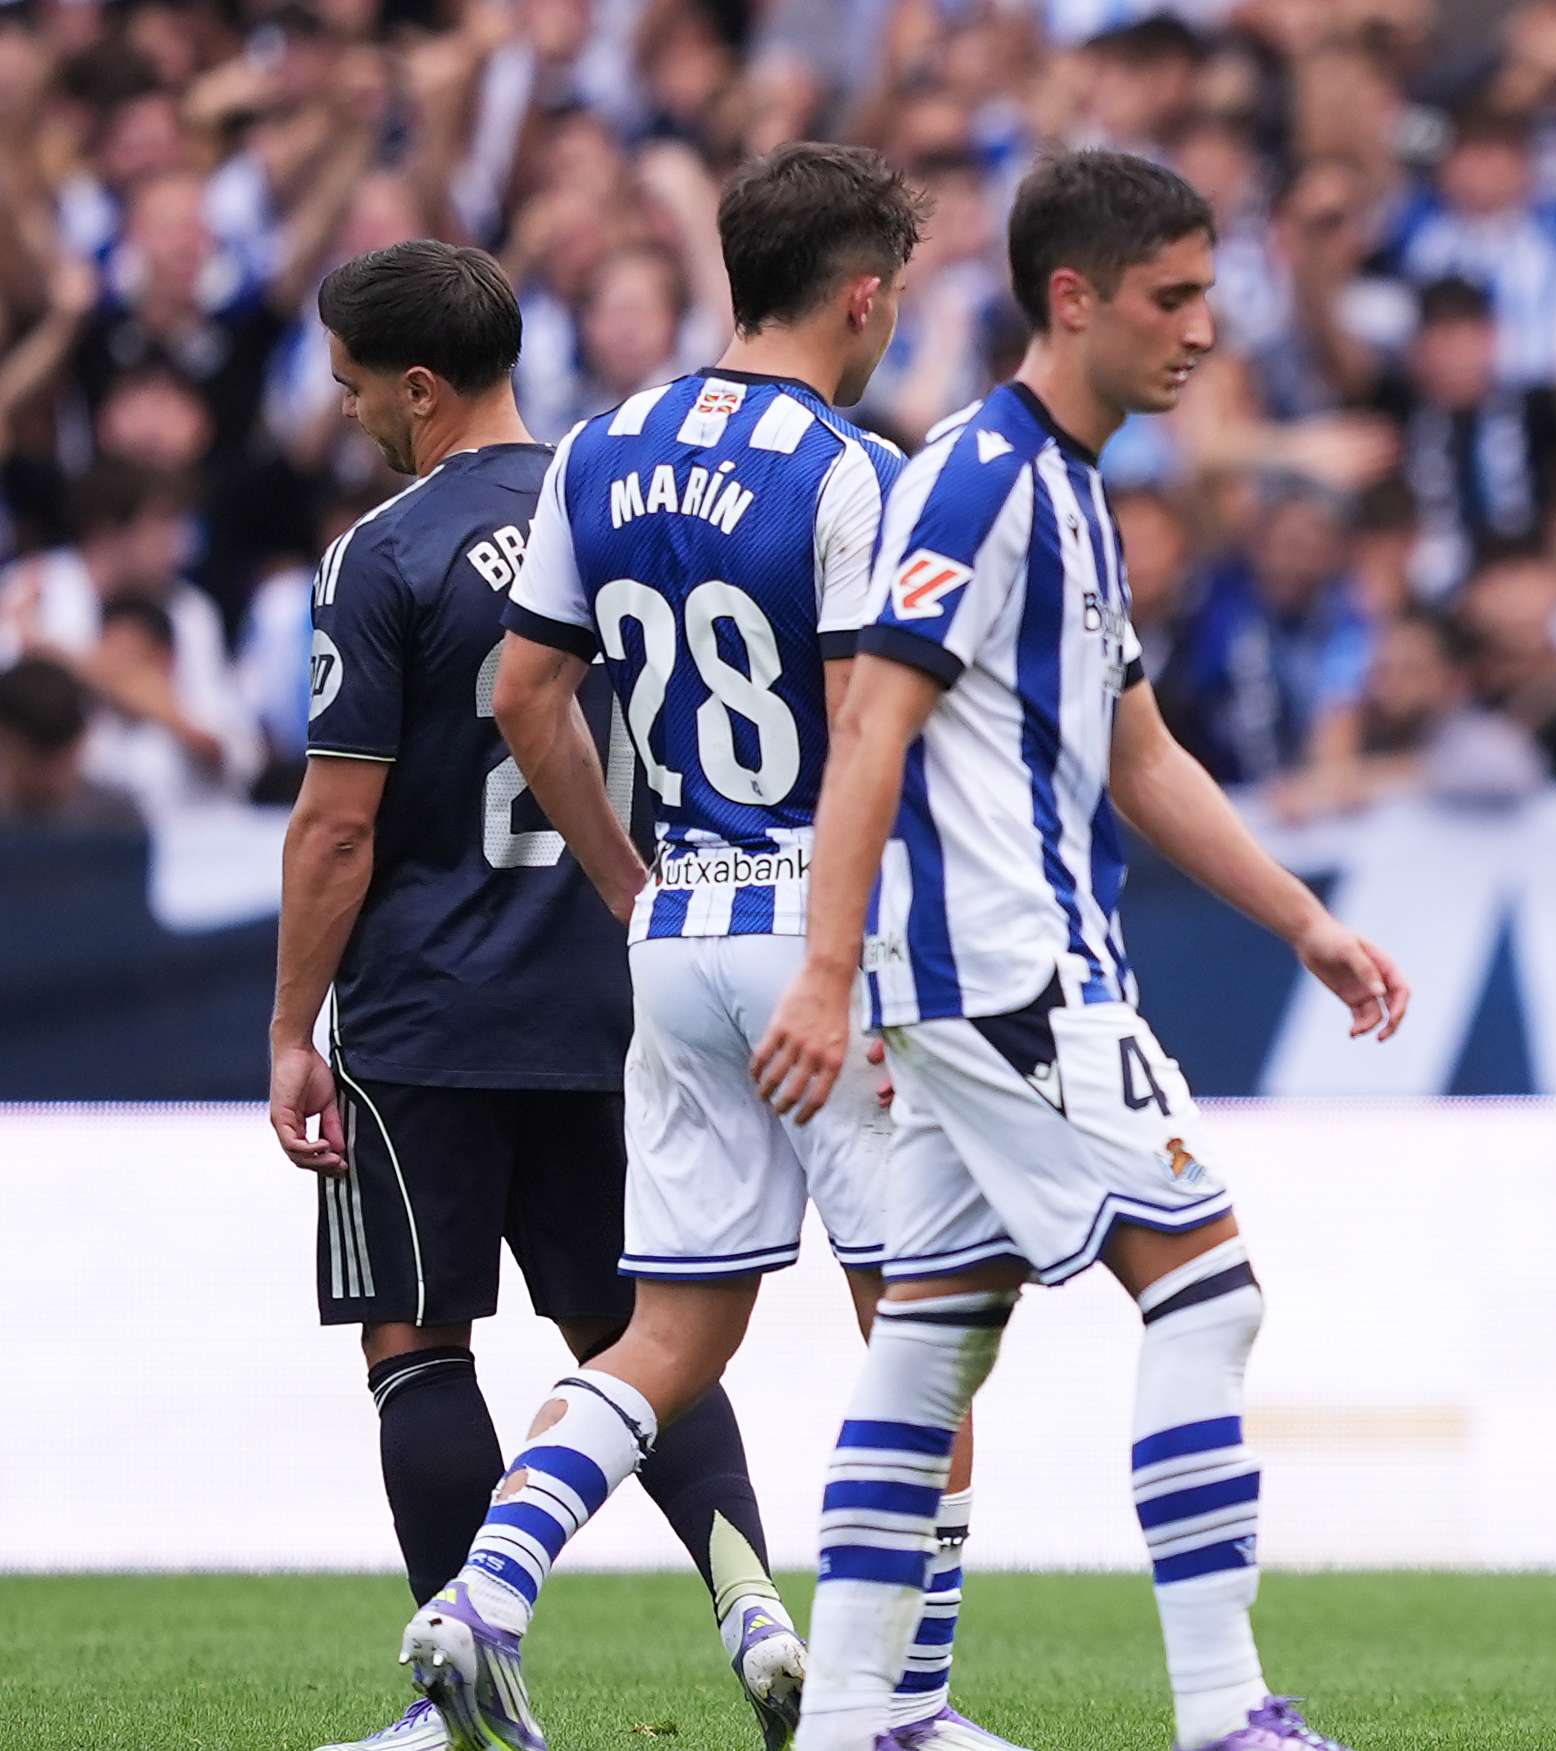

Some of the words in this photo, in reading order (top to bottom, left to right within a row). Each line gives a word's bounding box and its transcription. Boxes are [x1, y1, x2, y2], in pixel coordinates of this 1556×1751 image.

[611, 459, 754, 535] MARÍN
[466, 520, 533, 592] BR
[595, 579, 800, 807] 28
[1118, 1035, 1171, 1116] 4
